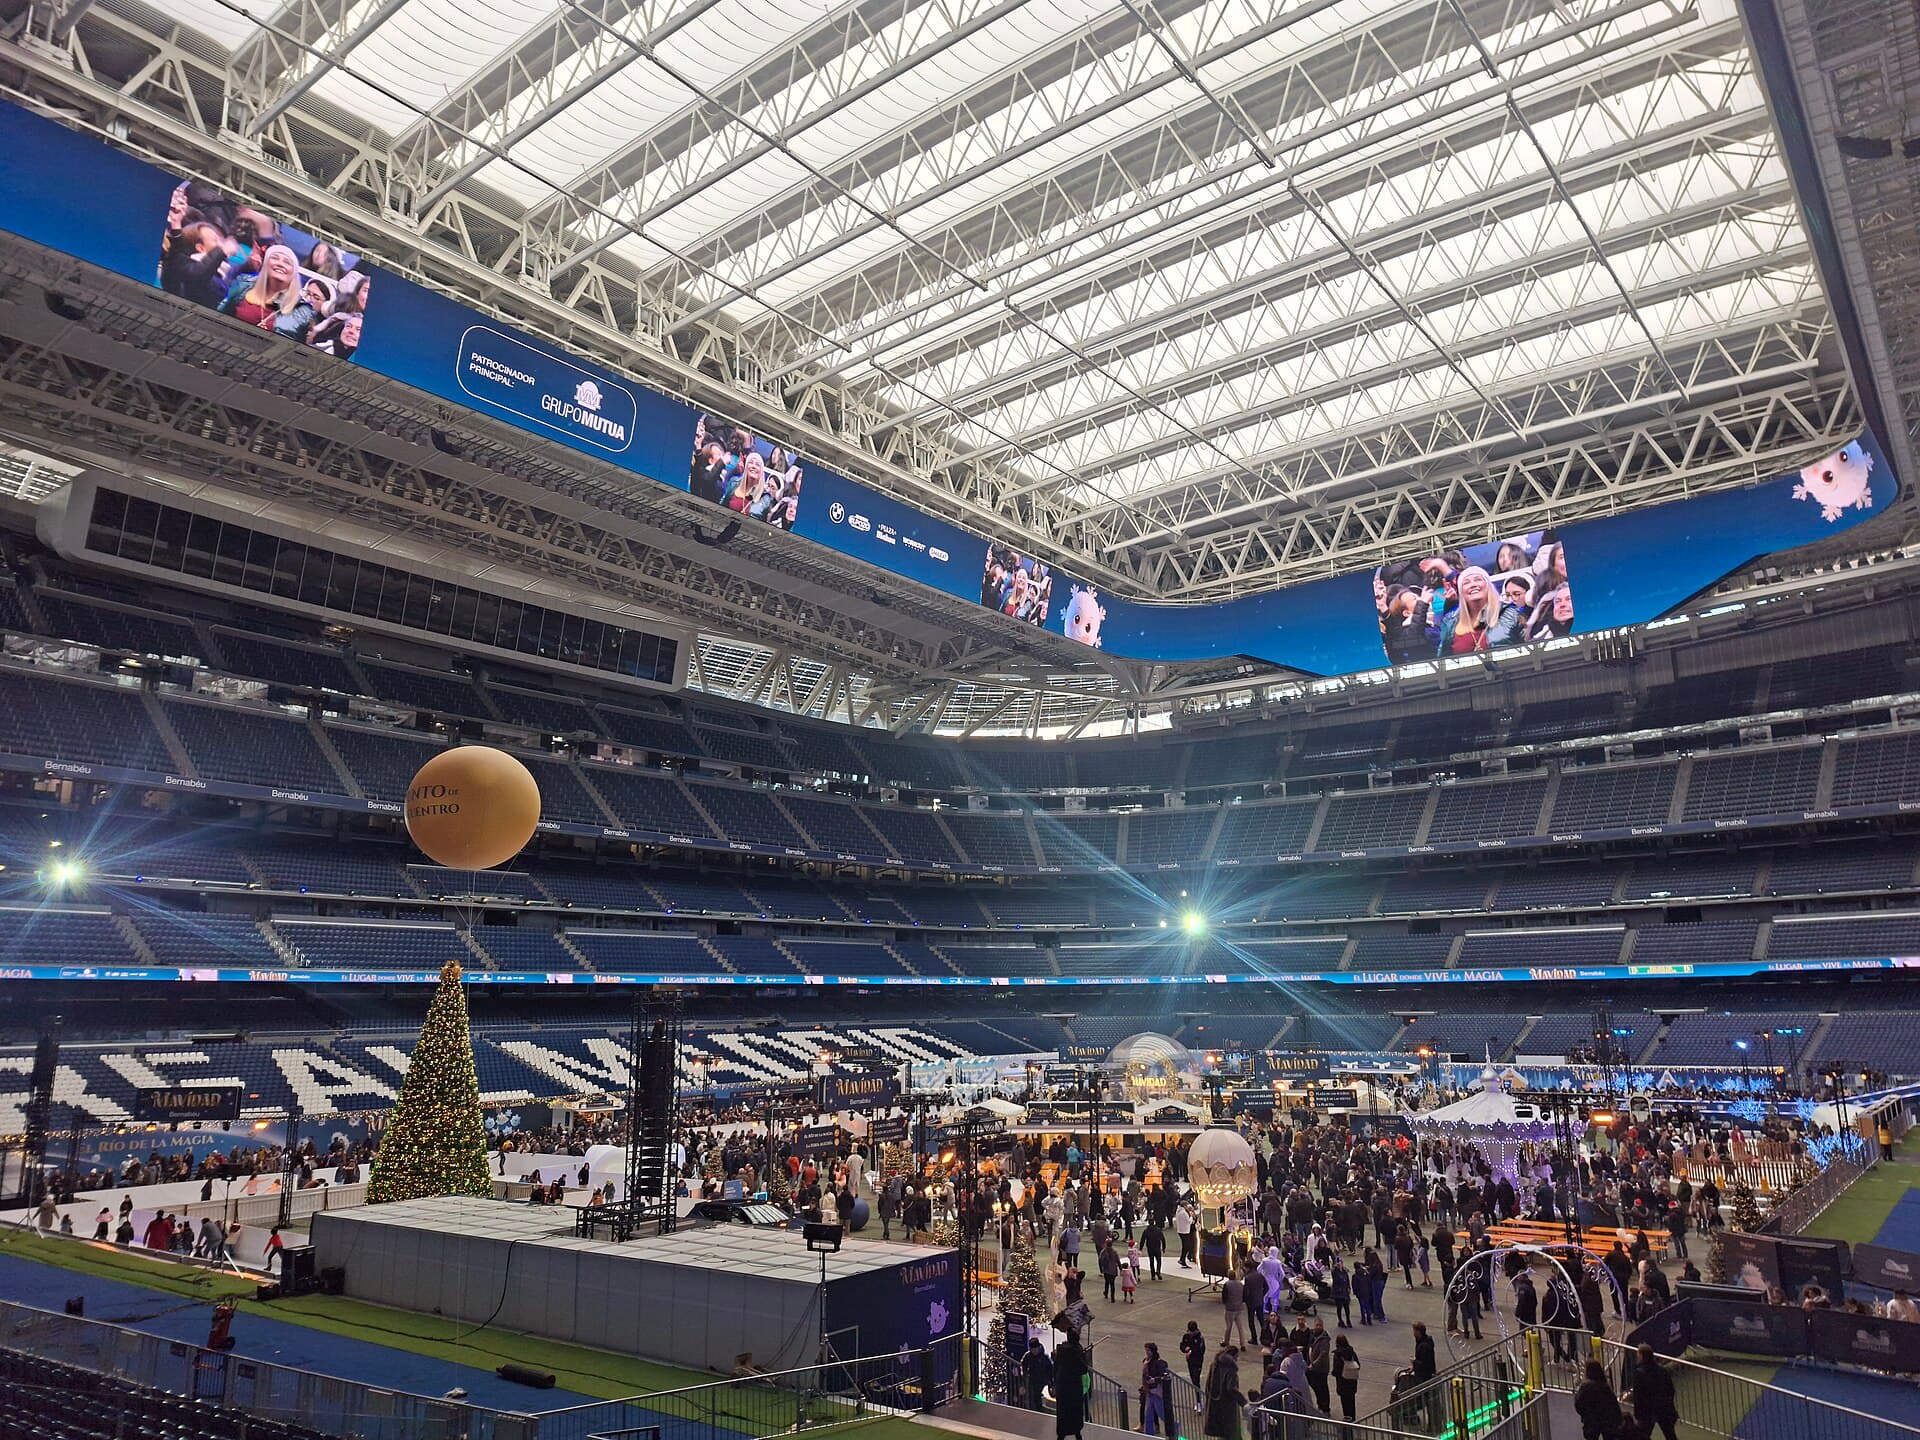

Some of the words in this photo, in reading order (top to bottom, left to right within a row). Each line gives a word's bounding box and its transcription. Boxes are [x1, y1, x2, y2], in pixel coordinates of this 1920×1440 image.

[471, 352, 536, 386] PATROCINADOR
[469, 363, 515, 388] PRINCIPAL:
[45, 760, 91, 775] Bernabéu
[165, 775, 206, 789] Bernabéu
[271, 789, 309, 801] Bernabéu
[368, 801, 400, 812] Bernabéu
[1803, 810, 1838, 821] Bernabéu
[1714, 818, 1747, 829] Bernabéu
[604, 828, 629, 838] Bernabéu
[1631, 826, 1662, 836] Bernabéu
[669, 835, 693, 844] Bernabéu
[1478, 839, 1506, 849] Bernabéu
[729, 842, 752, 851] Bernabéu
[1408, 845, 1434, 854] Bernabéu
[1775, 962, 1803, 970] LUGAR
[1822, 961, 1841, 969] VIVE
[1852, 960, 1882, 969] MAGIA
[349, 973, 377, 982] LUGAR
[396, 974, 415, 982] VIVE
[1362, 973, 1397, 982] LUGAR
[1424, 972, 1449, 981] VIVE
[1464, 971, 1504, 981] MAGIA
[98, 1138, 126, 1152] RÍO
[129, 1140, 147, 1151] DE
[151, 1138, 167, 1148] LA
[170, 1134, 215, 1147] MAGIA
